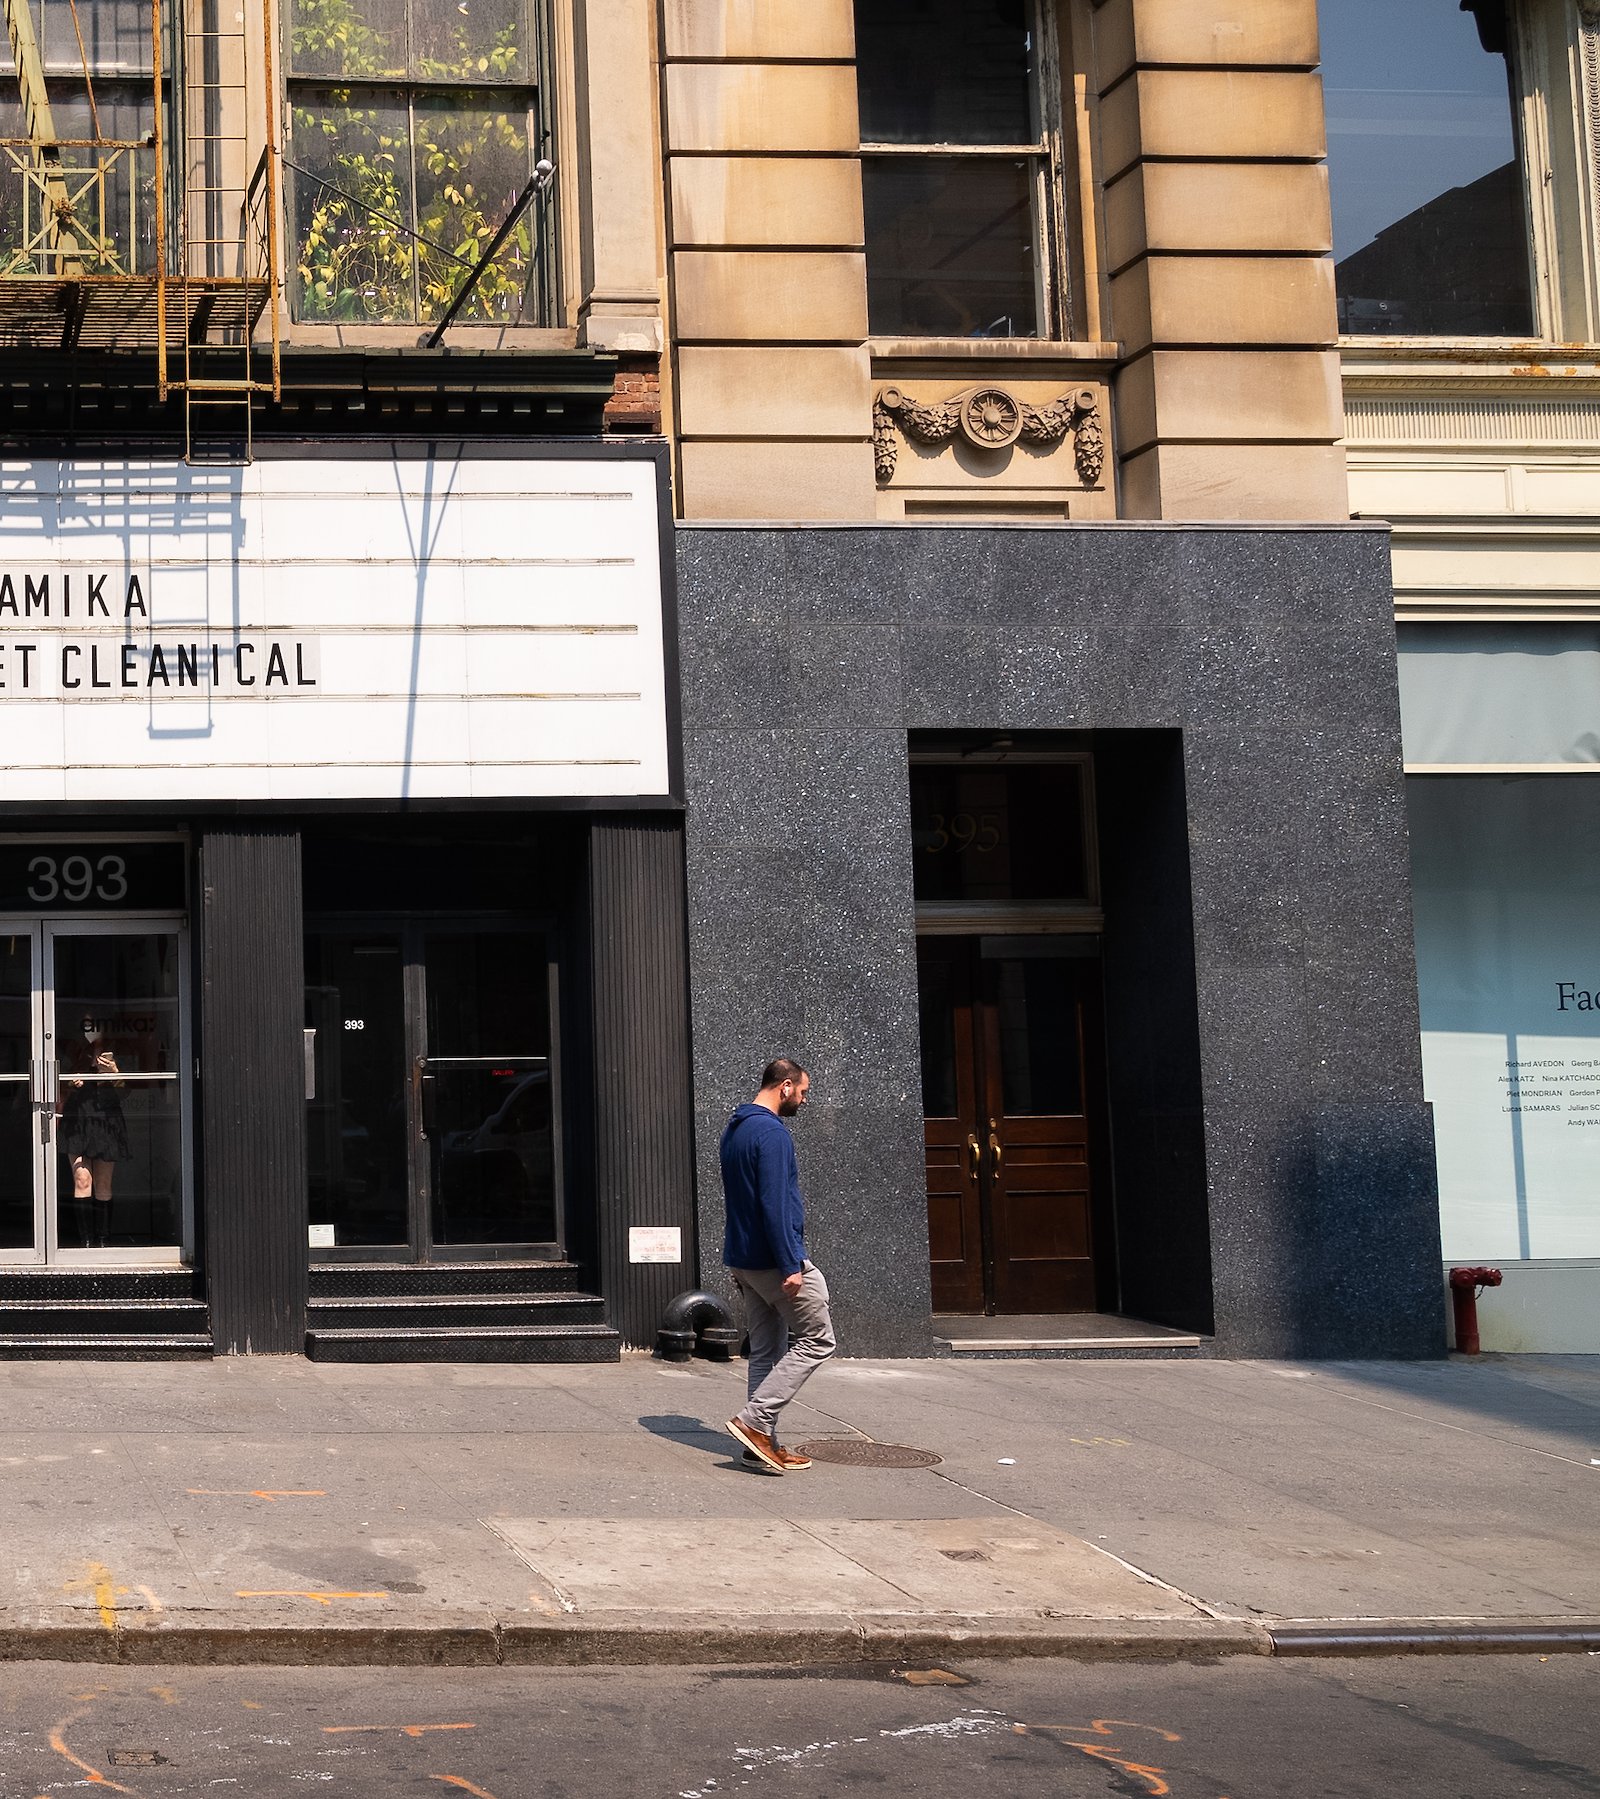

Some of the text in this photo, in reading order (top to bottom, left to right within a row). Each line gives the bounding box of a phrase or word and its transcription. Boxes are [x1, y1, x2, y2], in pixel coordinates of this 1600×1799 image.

[60, 641, 319, 690] CLEANICAL
[925, 812, 1001, 855] 395
[26, 854, 129, 903] 393
[344, 1019, 365, 1030] 393
[1505, 1060, 1532, 1068] Richard
[1533, 1060, 1565, 1068] AVEDON
[1570, 1060, 1592, 1069] Georg
[1498, 1075, 1513, 1083] Alex
[1514, 1075, 1536, 1083] KATZ
[1506, 1090, 1521, 1098] Piet
[1521, 1090, 1563, 1098] MONDRIAN
[1502, 1105, 1522, 1113] Lucas
[1523, 1104, 1561, 1112] SAMARAS
[1567, 1119, 1586, 1127] Andy
